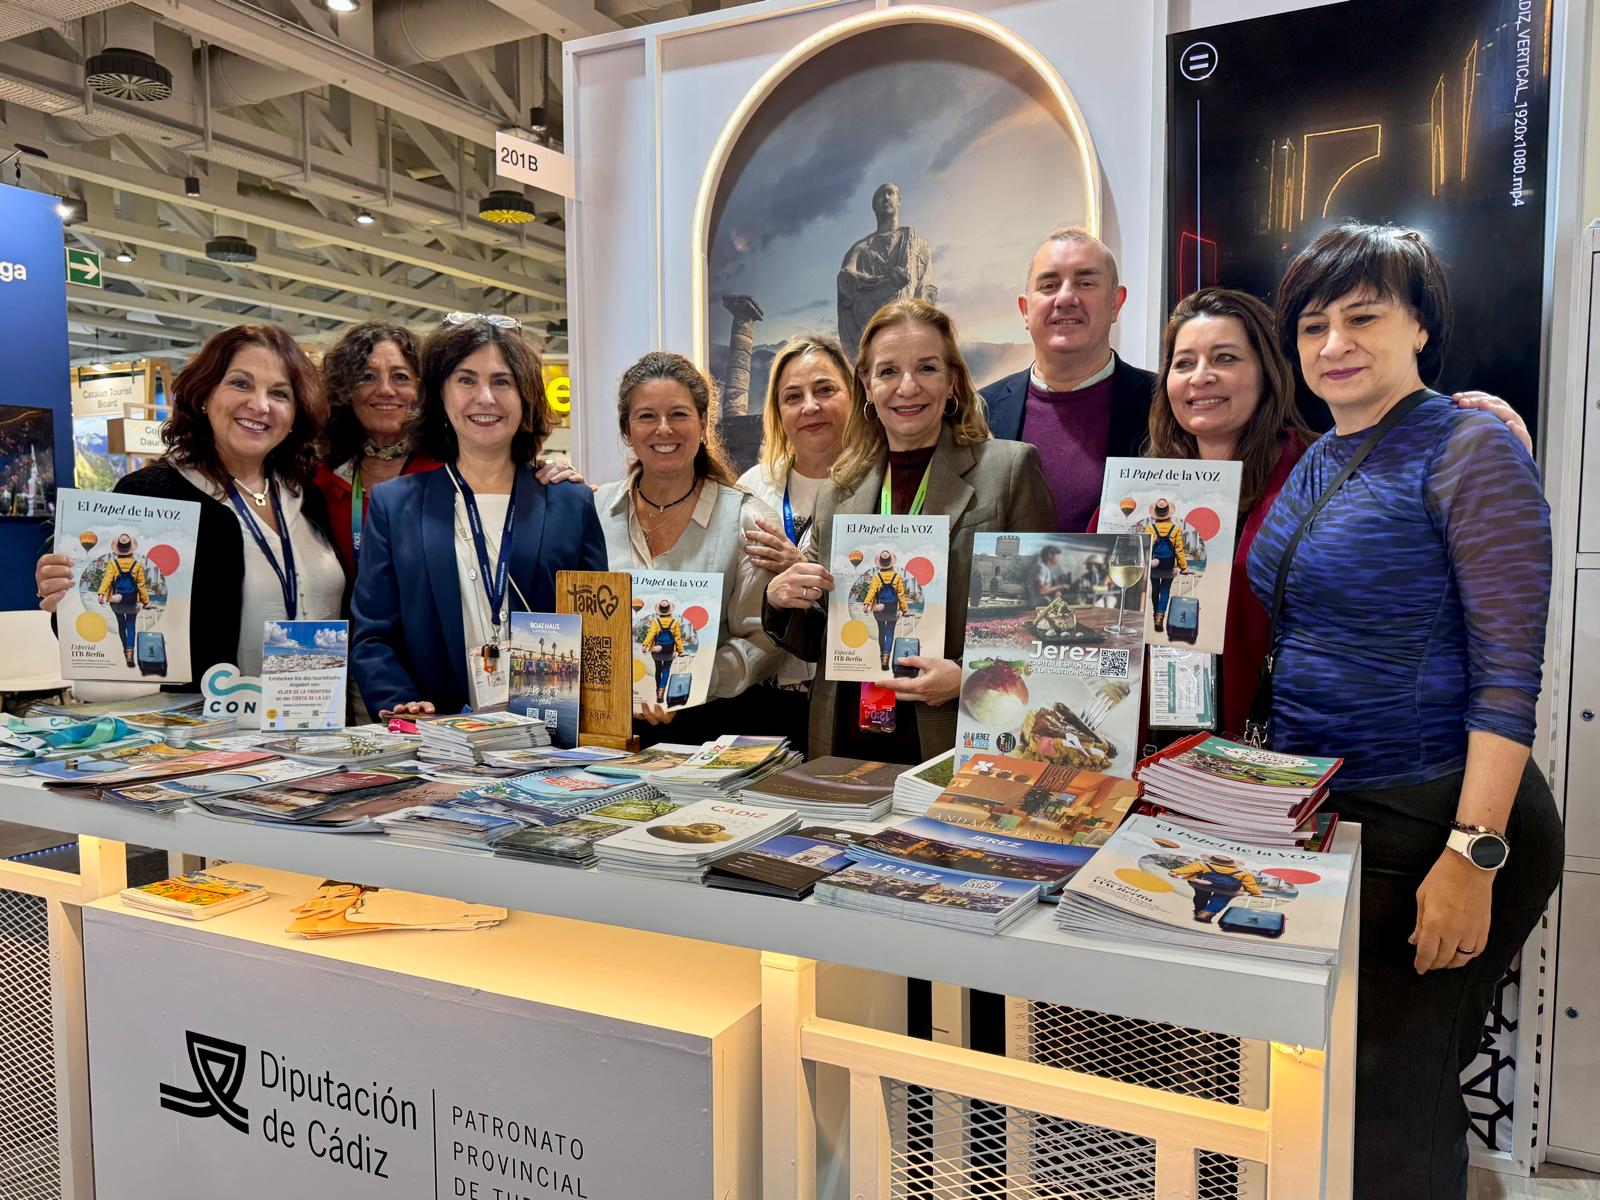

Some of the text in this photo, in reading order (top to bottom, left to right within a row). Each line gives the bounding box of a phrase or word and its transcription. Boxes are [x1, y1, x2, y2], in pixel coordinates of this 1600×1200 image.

[501, 147, 538, 172] 201B
[82, 386, 133, 400] Catalan Tourist
[97, 399, 118, 409] Board
[1120, 468, 1221, 482] El Papel de la VOZ
[77, 501, 181, 520] El Papel de la VOZ
[847, 524, 933, 535] El Papel de la VOZ
[632, 576, 709, 589] El Papel de la VOZ
[70, 643, 96, 651] Especial
[85, 650, 105, 658] Berlin
[1029, 640, 1099, 662] Jerez
[1028, 660, 1058, 668] CAPITAL
[969, 835, 1024, 849] JEREZ
[1155, 823, 1172, 833] El
[1177, 831, 1227, 848] Papel
[1229, 846, 1251, 854] de
[1277, 852, 1319, 861] VOZ
[868, 862, 944, 882] JEREZ
[260, 1050, 417, 1130] Diputación
[452, 1105, 584, 1161] PATRONATO
[263, 1108, 389, 1179] de Cádiz
[453, 1141, 588, 1199] PROVINCIAL
[454, 1177, 480, 1200] DE
